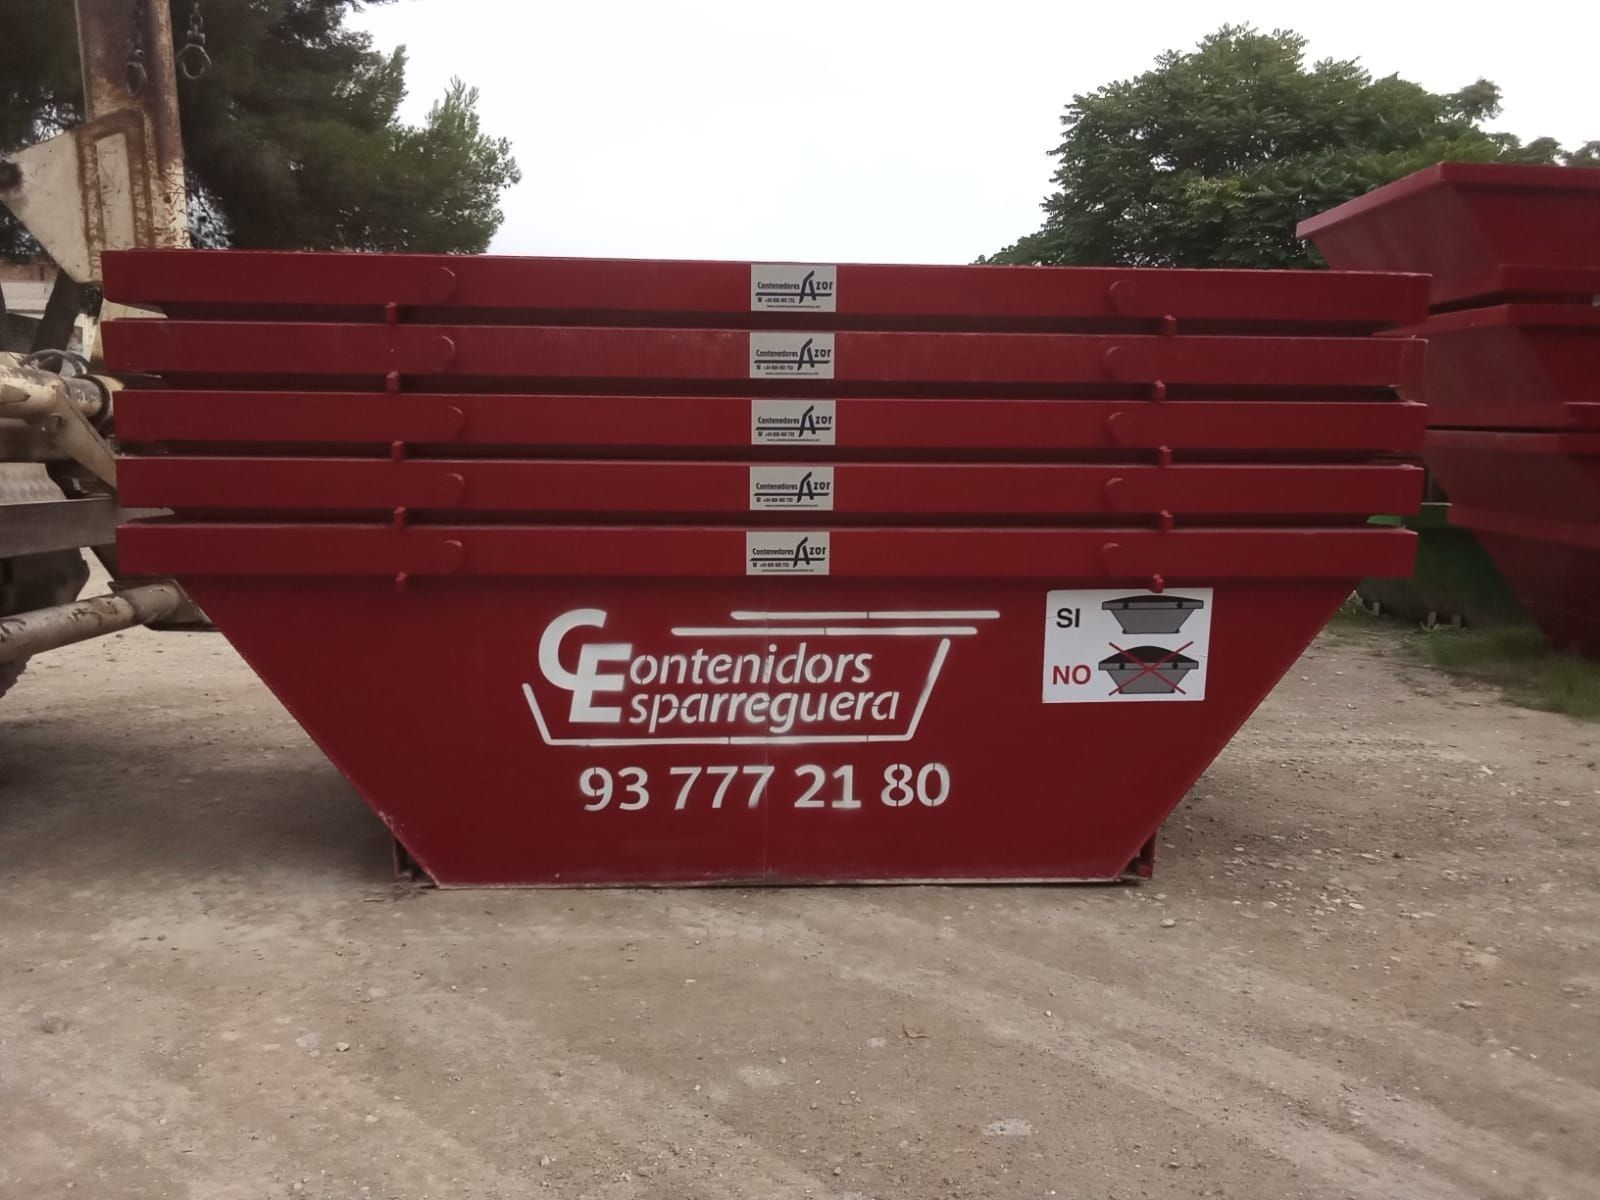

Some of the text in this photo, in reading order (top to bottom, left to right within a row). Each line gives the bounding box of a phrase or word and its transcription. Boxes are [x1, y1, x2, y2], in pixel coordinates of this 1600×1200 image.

[799, 270, 833, 304] Azor
[797, 338, 832, 371] Azor
[799, 405, 833, 437] Azor
[797, 471, 831, 503] Azor
[793, 536, 827, 568] Azor
[1056, 608, 1081, 628] SI
[538, 609, 873, 691] Contenidors
[569, 643, 900, 733] Esparreguera
[1052, 664, 1092, 685] NO
[579, 763, 951, 811] 93 777 21 80
